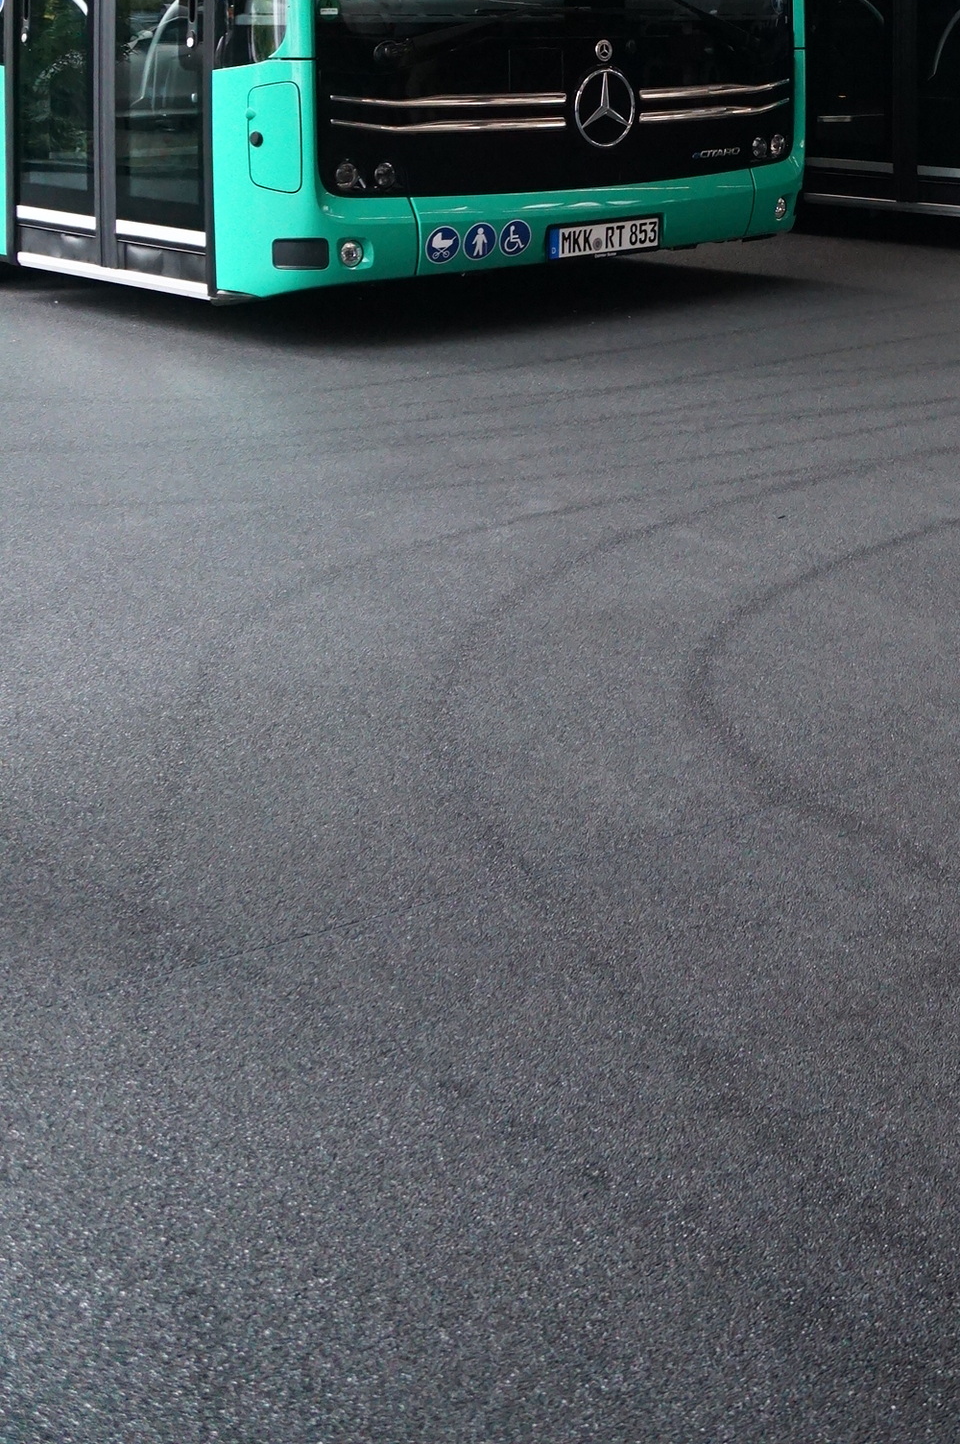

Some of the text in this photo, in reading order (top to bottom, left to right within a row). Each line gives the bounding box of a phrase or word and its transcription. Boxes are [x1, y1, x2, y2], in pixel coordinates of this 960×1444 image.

[561, 228, 593, 254] MKK
[605, 225, 626, 248] RT
[629, 221, 657, 246] 853
